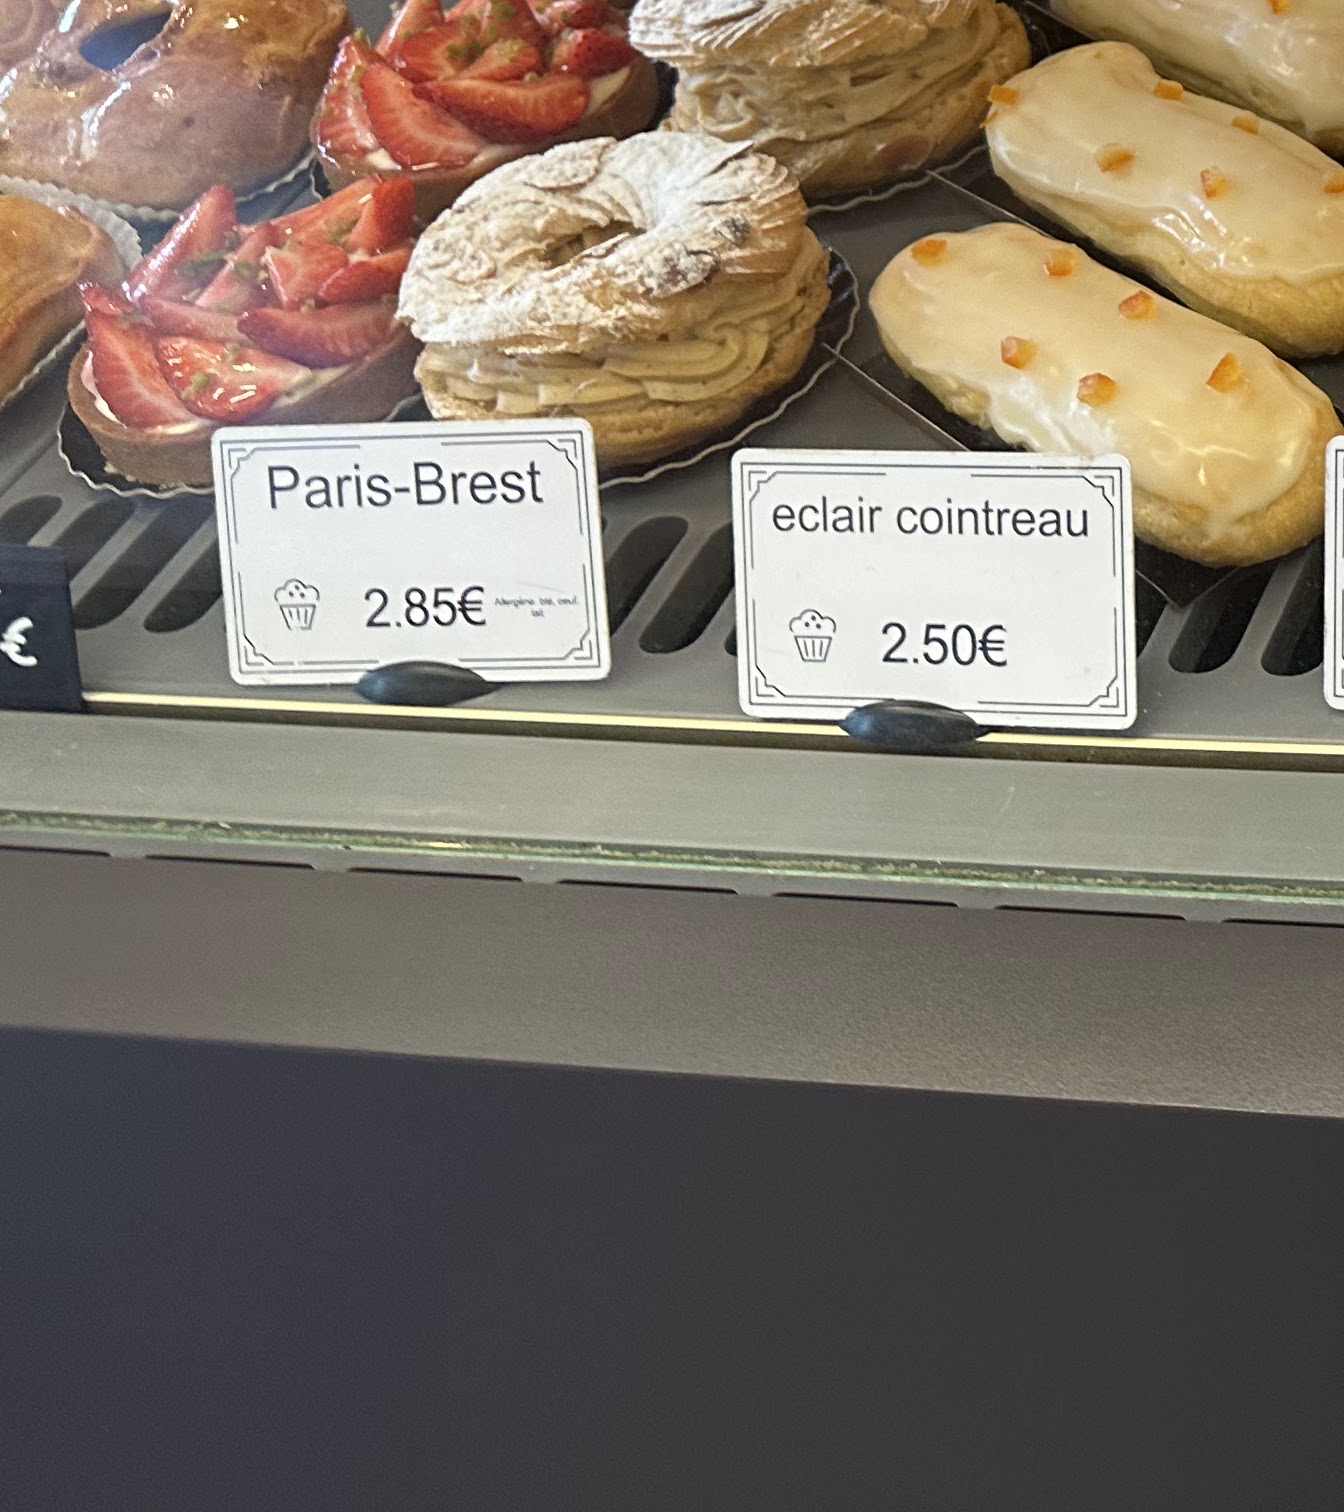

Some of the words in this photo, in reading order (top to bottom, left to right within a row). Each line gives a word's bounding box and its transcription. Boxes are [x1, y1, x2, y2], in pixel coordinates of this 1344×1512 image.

[267, 460, 544, 510] Paris-Brest
[771, 496, 883, 534] eclair
[896, 499, 1089, 538] cointreau
[364, 586, 488, 629] 2.85€
[881, 621, 1008, 667] 2.50€
